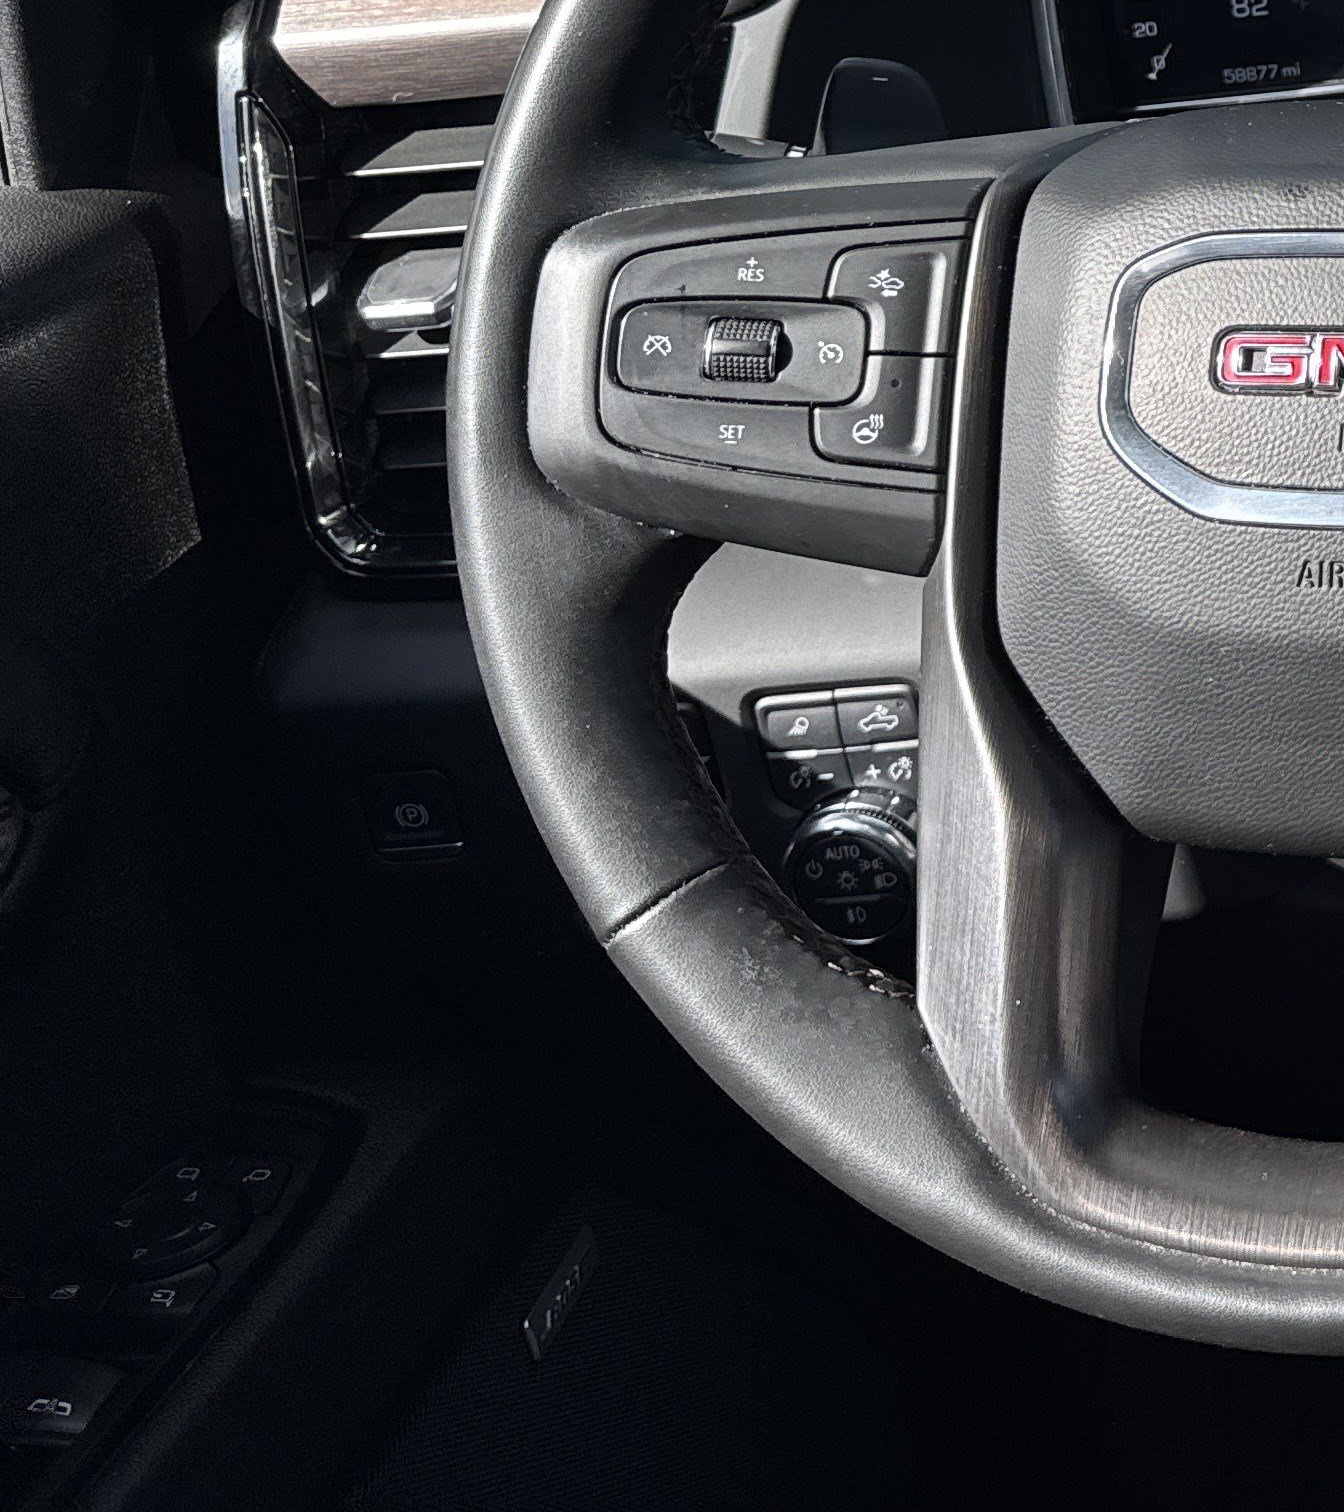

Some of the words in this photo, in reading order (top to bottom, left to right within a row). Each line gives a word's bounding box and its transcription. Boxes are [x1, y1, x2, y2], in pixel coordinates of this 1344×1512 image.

[1132, 21, 1158, 38] 20
[1223, 65, 1279, 84] 58877
[1281, 62, 1301, 78] mi
[737, 267, 765, 283] RES
[718, 424, 746, 441] SET
[825, 844, 860, 862] AUTO
